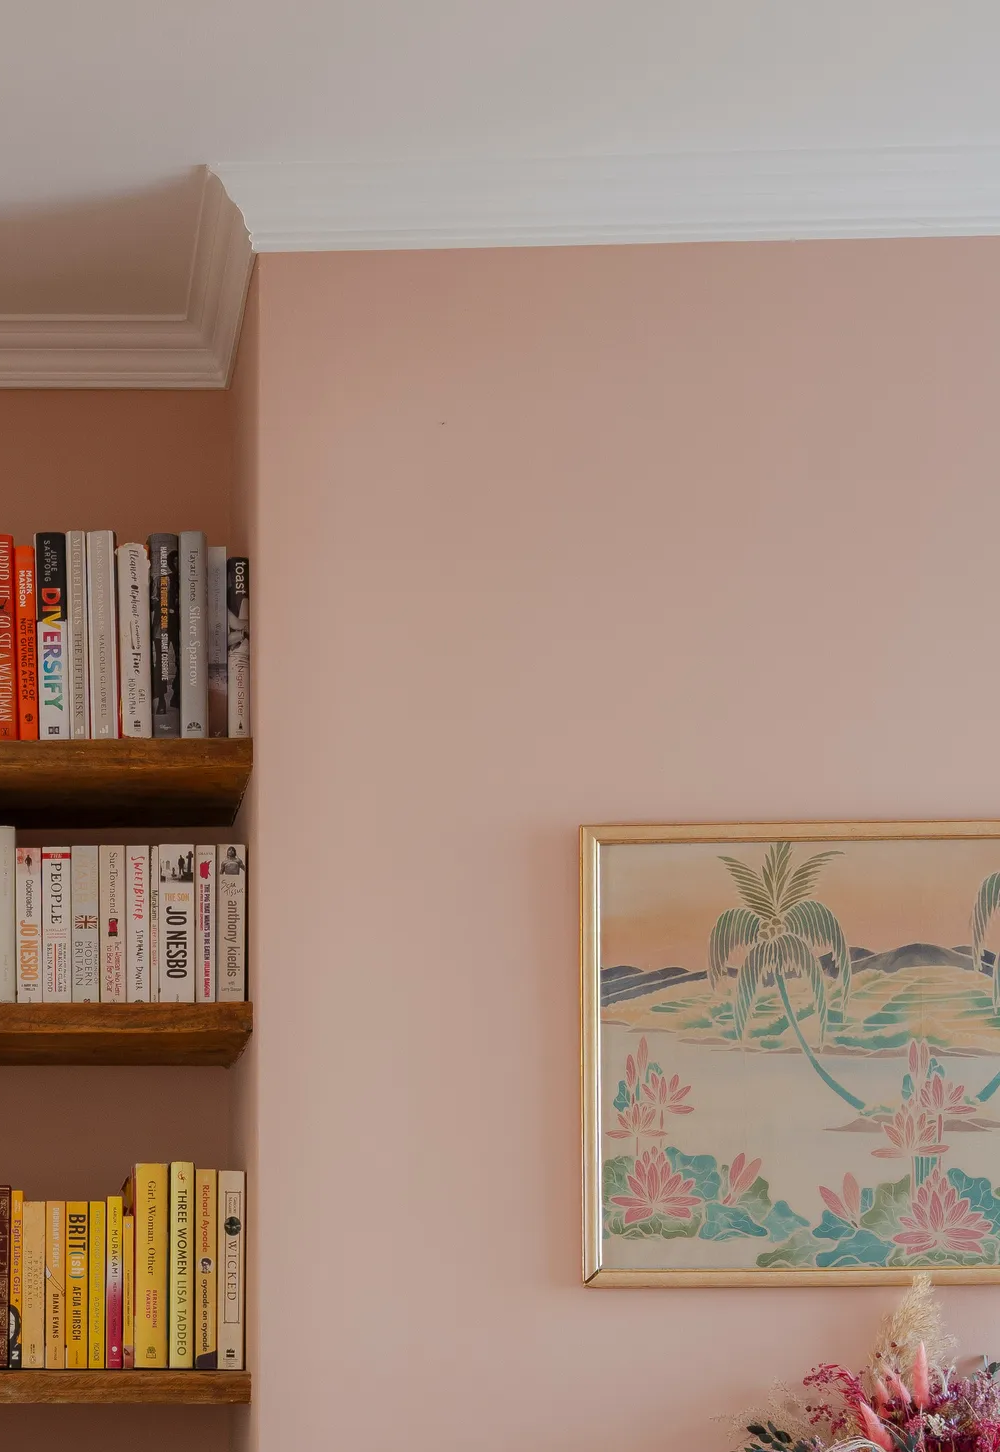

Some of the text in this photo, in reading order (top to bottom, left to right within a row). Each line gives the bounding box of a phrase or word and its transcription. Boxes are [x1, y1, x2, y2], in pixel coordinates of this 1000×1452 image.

[44, 540, 52, 582] SARPONG
[235, 562, 246, 594] toast
[186, 548, 200, 687] Tayari Jones Silver Sparrow
[42, 588, 63, 711] DIVERSIFY
[235, 666, 245, 717] Nigel Slater
[51, 862, 62, 924] PEOPLE
[166, 906, 187, 979] JO NESBO
[224, 900, 240, 976] anthony kiedis
[148, 1248, 156, 1275] Other
[177, 1189, 186, 1356] THREE WOMEN LISA TADDEO
[227, 1241, 237, 1301] WICKED
[72, 1286, 81, 1307] AFUA
[72, 1310, 81, 1340] HIRSCH
